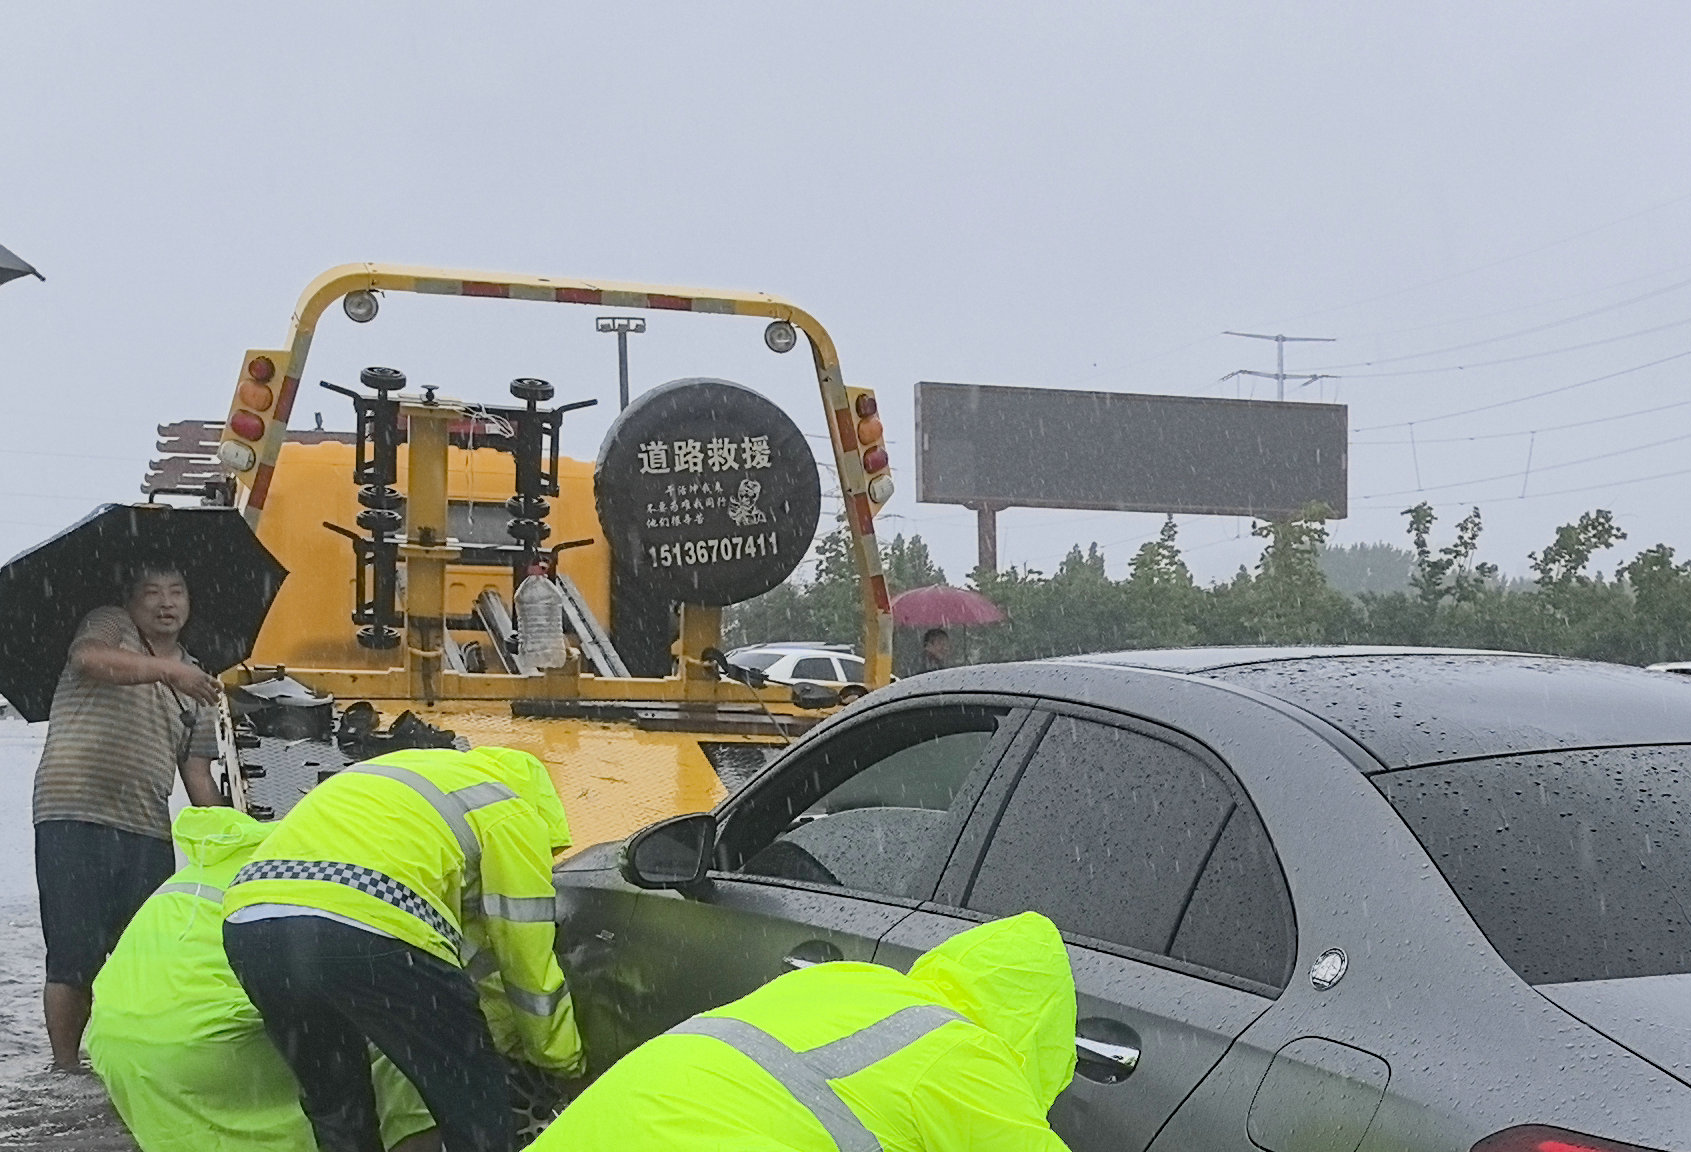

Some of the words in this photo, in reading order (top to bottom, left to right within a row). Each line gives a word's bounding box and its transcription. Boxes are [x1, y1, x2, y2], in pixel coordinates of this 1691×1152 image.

[638, 435, 772, 474] 道路救援
[649, 532, 778, 567] 15136707411
